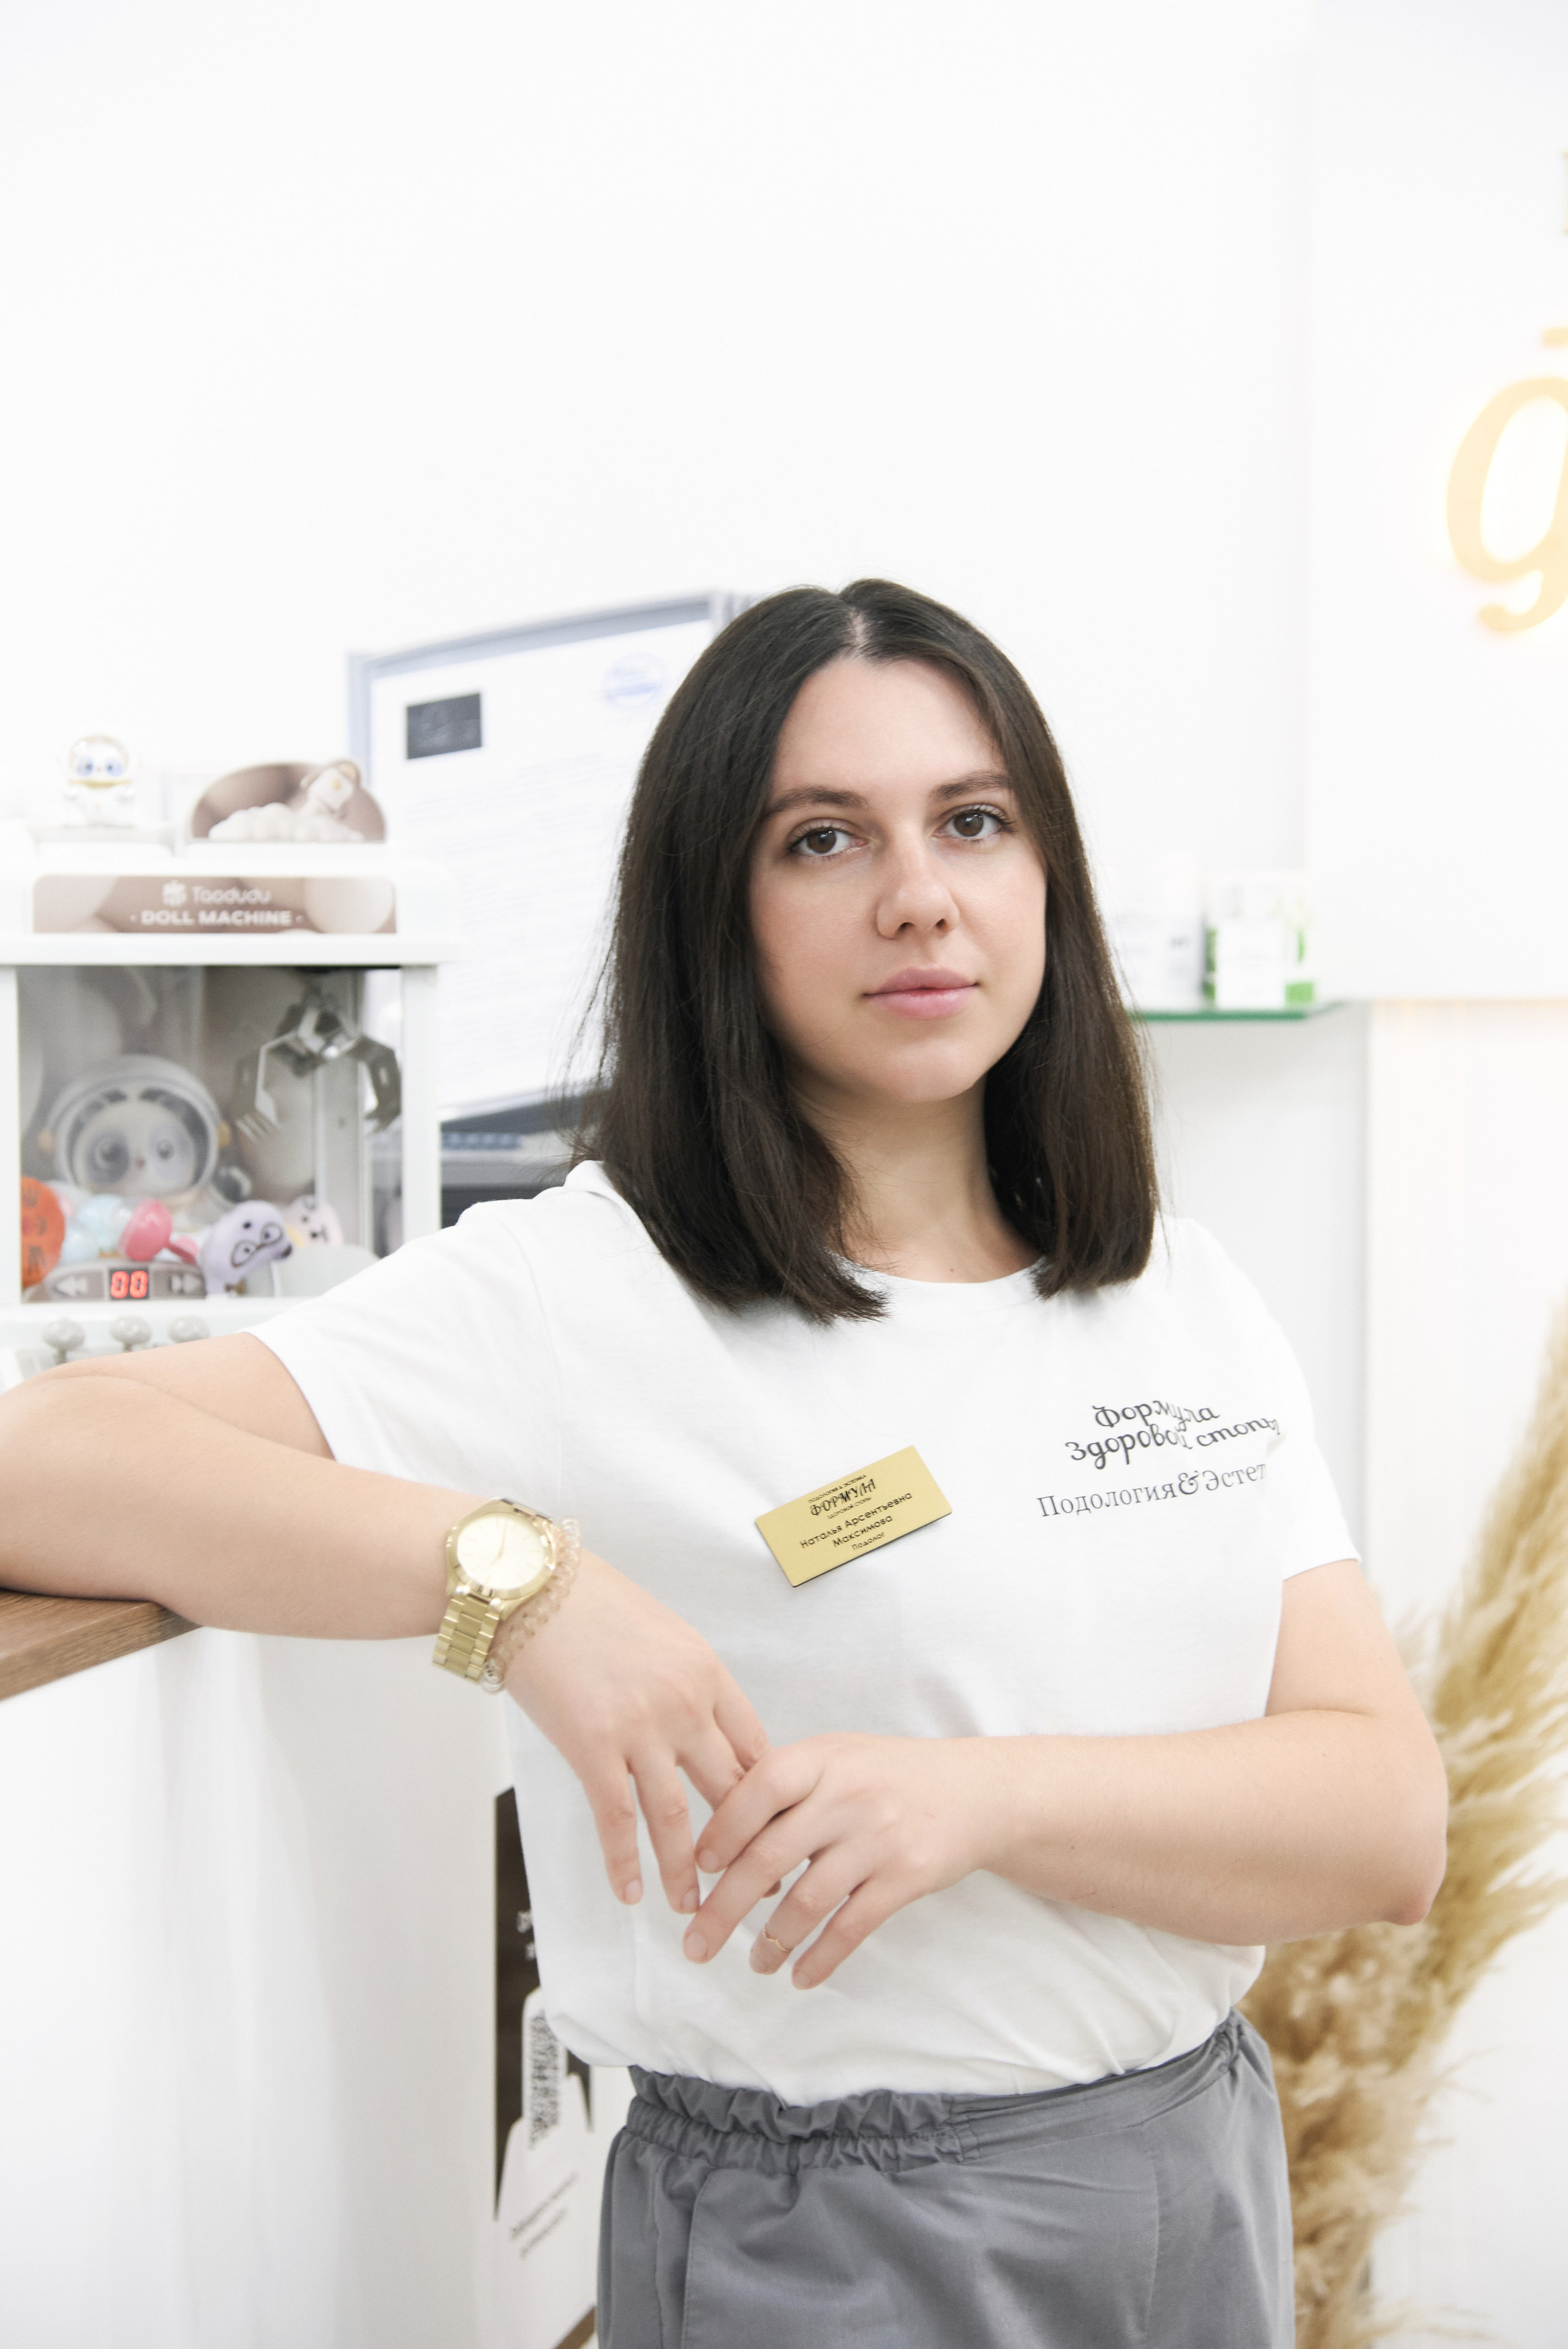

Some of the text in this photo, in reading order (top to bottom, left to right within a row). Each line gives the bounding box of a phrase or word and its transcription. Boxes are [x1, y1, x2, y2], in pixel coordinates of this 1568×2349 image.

[141, 910, 293, 926] DOLL MACHINE
[110, 1271, 148, 1299] 00
[810, 1479, 876, 1516] ФОРМУЛА
[799, 1493, 912, 1548] Наталья Арсентьевна
[832, 1516, 893, 1547] Максимова
[851, 1532, 885, 1550] Подолог
